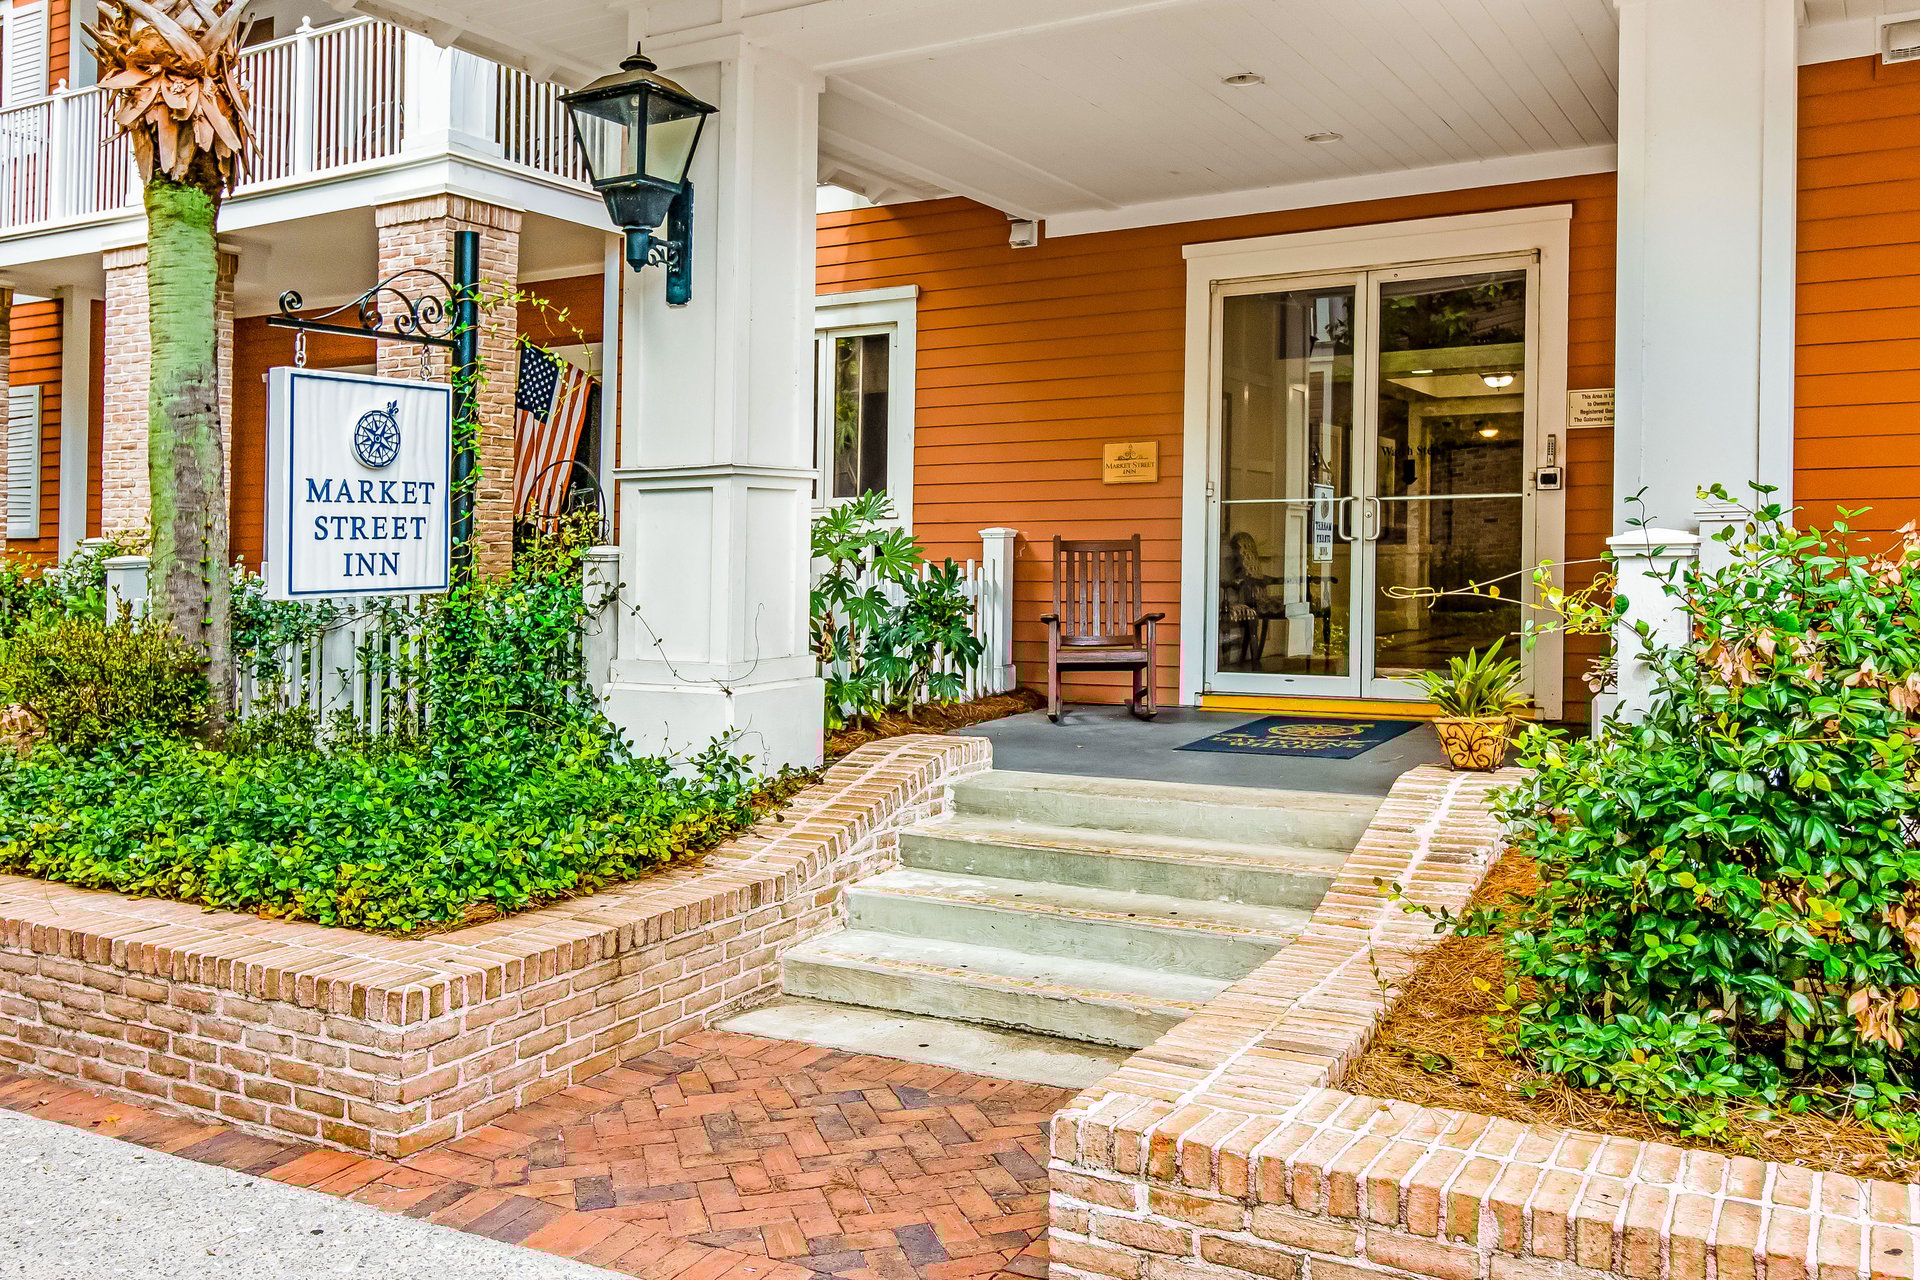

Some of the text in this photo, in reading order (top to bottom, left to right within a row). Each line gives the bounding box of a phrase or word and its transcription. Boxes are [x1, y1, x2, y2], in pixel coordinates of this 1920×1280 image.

[1380, 445, 1440, 456] Wah Ste
[305, 478, 435, 505] MARKET
[314, 515, 427, 541] STREET
[343, 552, 401, 577] INN
